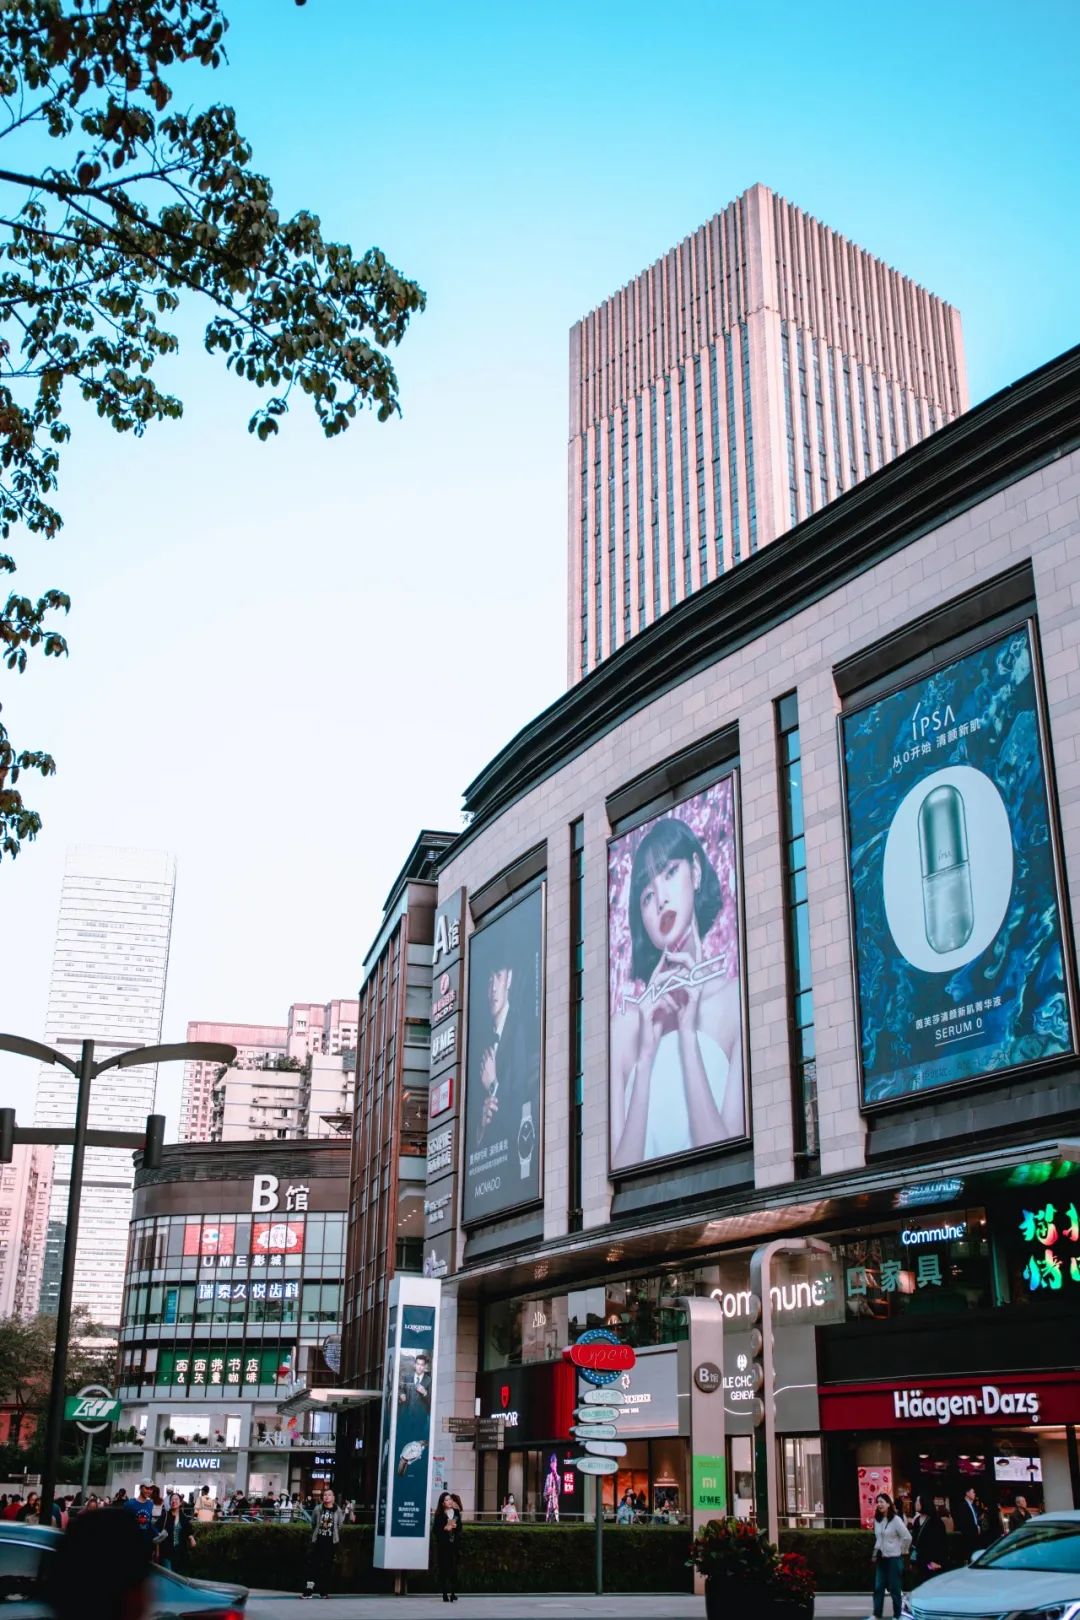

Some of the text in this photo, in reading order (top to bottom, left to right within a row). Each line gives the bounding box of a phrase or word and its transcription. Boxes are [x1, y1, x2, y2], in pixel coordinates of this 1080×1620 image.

[912, 702, 955, 741] IPSA
[935, 1021, 972, 1041] SERUM
[203, 1256, 247, 1267] UME
[200, 1282, 300, 1300] 瑞泰久悦齿科
[176, 1358, 259, 1372] 西西弗书店
[176, 1458, 221, 1469] HUAWEI
[700, 1495, 721, 1504] UME
